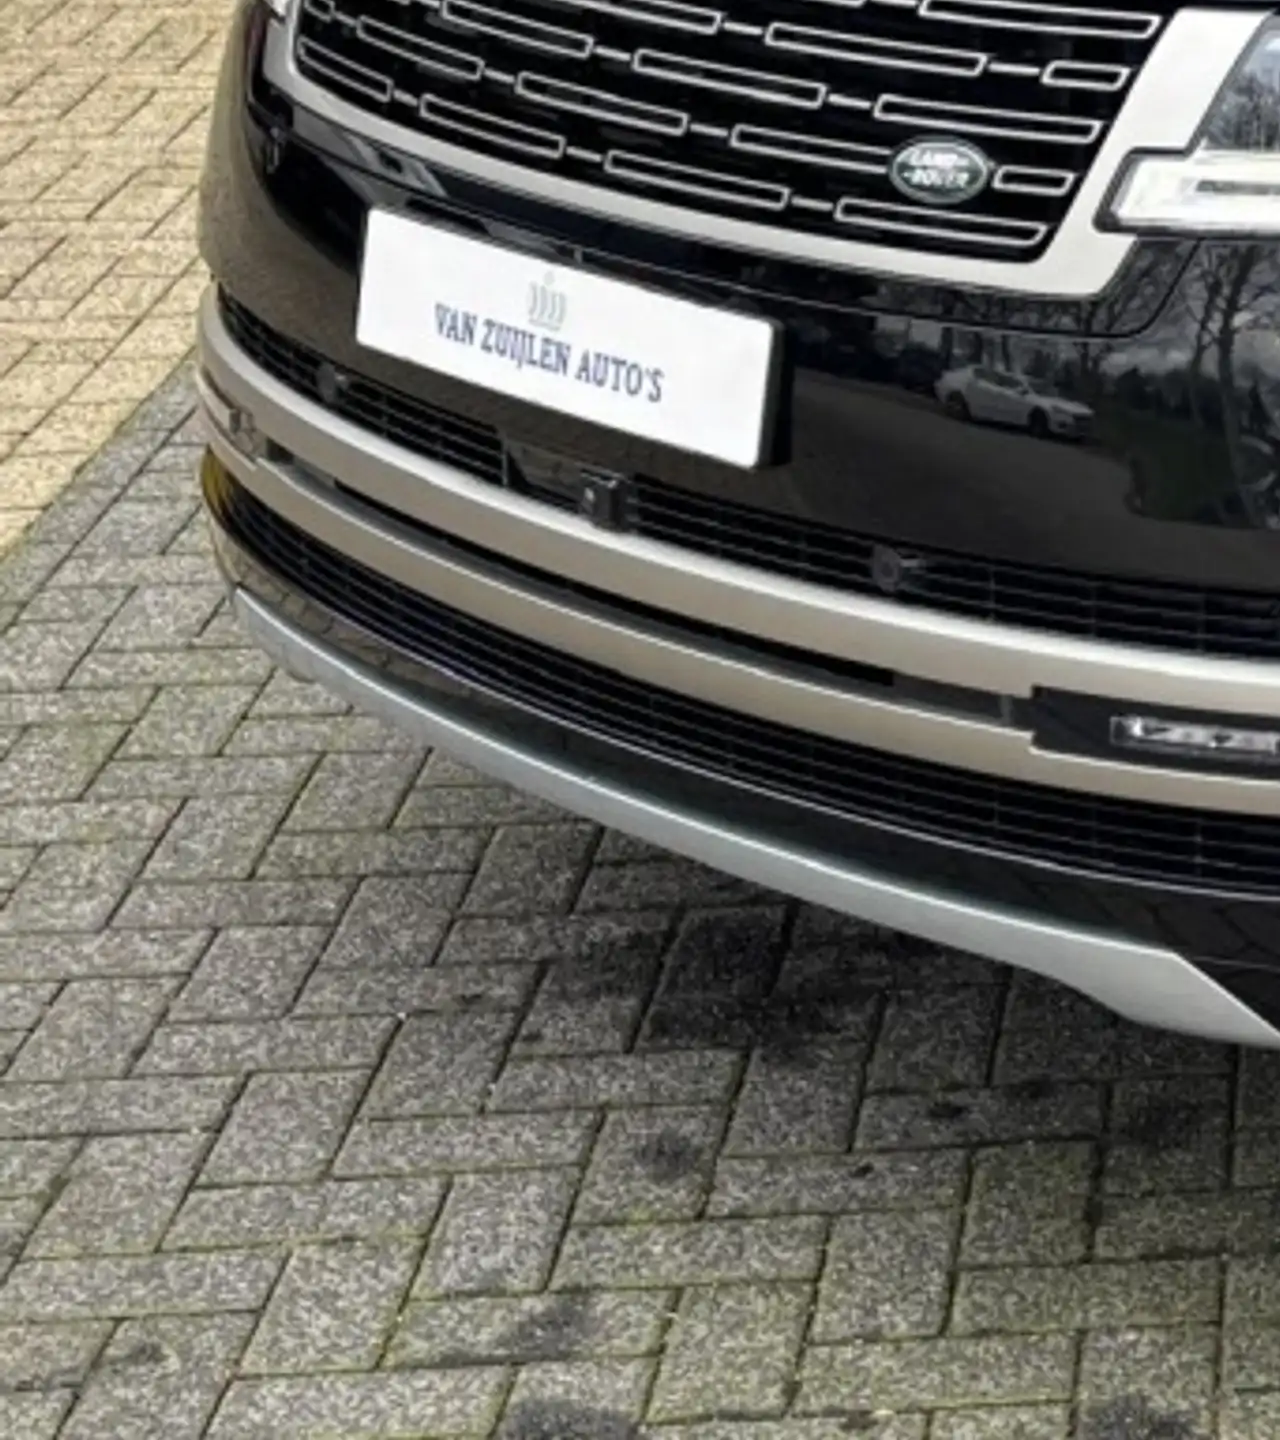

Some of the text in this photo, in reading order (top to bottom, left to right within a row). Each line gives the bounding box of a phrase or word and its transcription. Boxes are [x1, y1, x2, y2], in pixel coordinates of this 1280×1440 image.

[435, 302, 665, 403] VAN ZUIJLEN AUTO'S
